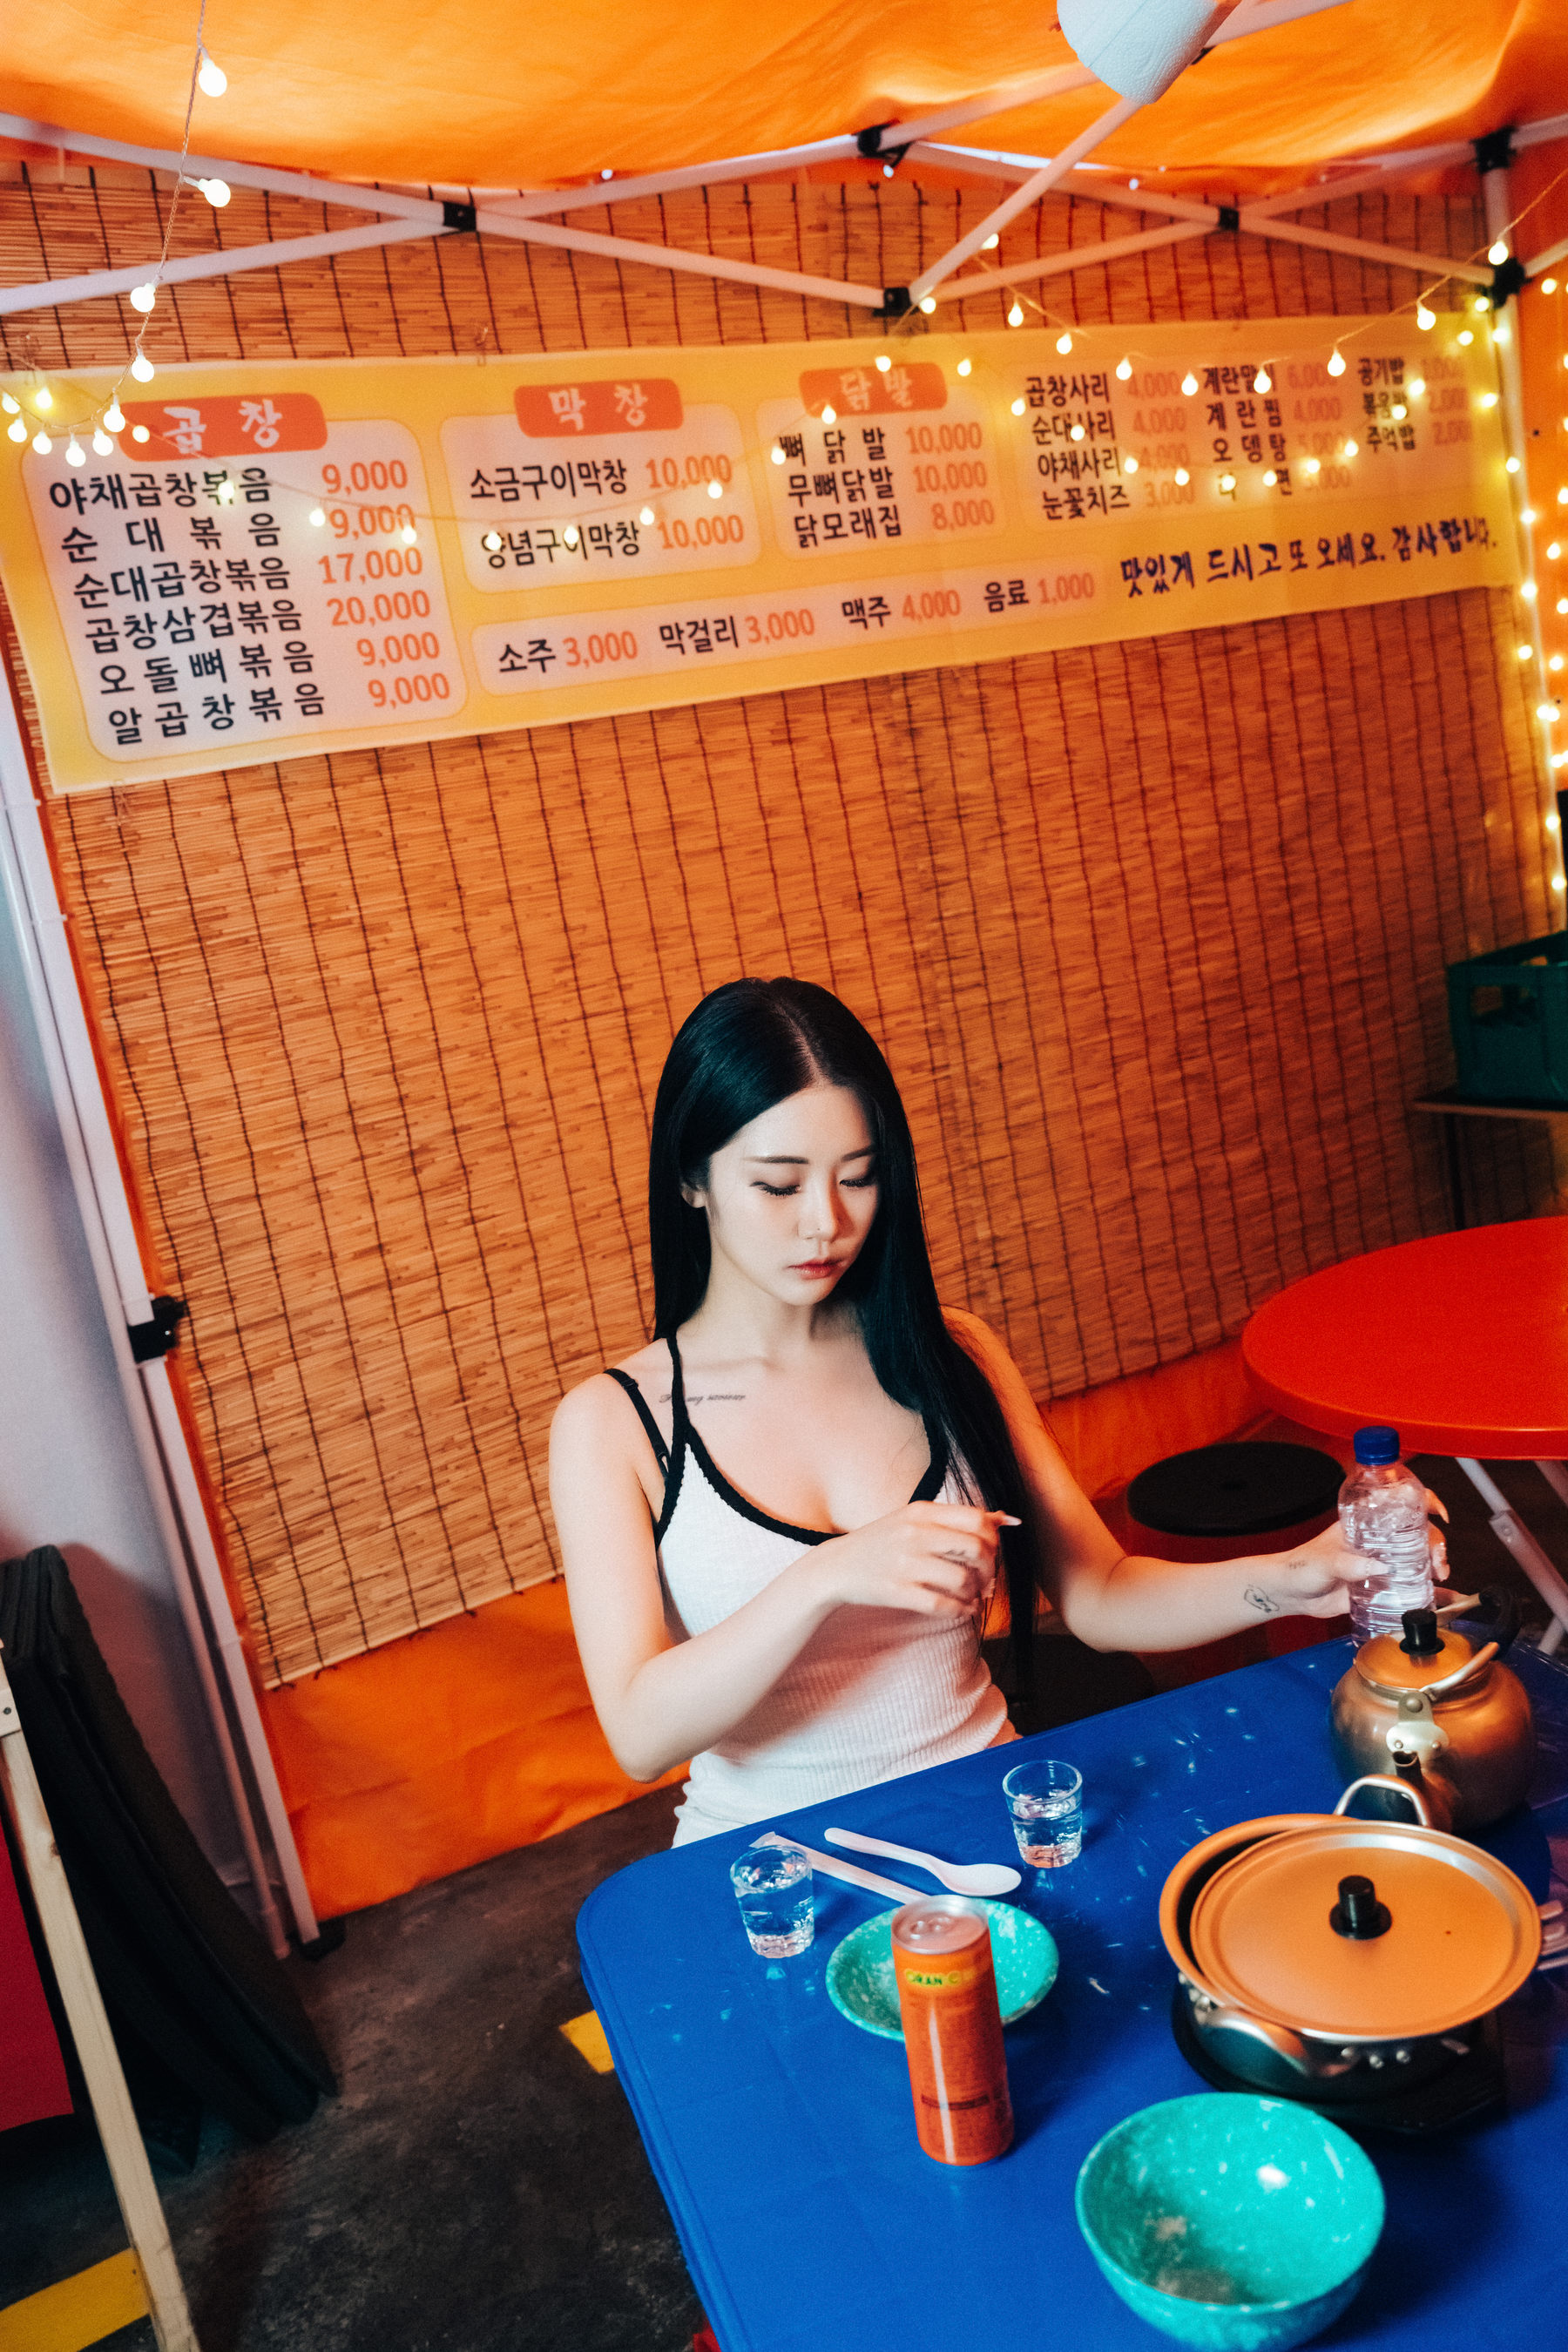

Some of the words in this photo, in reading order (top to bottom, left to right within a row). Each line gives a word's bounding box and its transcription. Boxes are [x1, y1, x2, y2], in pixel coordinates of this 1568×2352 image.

[1026, 373, 1110, 408] 곱창사리
[905, 422, 983, 455] 10,000
[471, 459, 626, 502] 소금구이막창
[645, 455, 732, 490] 10,000
[788, 466, 895, 507] 무뼈닭발
[912, 461, 988, 494] 10,000
[1038, 448, 1121, 482] 야채사리
[50, 468, 271, 515] 야채곱창볶음
[322, 461, 408, 495] 9,000
[1044, 485, 1130, 520] 눈꽃치즈
[330, 504, 416, 539] 9,000
[658, 515, 743, 550] 10,000
[794, 505, 902, 548] 닭모래집
[931, 499, 995, 531] 8,000
[74, 557, 290, 608] 순대곱창볶음
[319, 548, 422, 585] 17,000
[1120, 551, 1194, 598] 맛있게
[86, 599, 301, 653] 곱창삼겹볶음
[327, 590, 430, 626] 20,000
[499, 639, 556, 672] 소주
[563, 631, 638, 667] 3,000
[660, 616, 739, 654] 막걸리
[745, 609, 814, 645] 3,000
[841, 597, 890, 629] 맥주
[902, 590, 961, 622] 4,000
[984, 580, 1029, 613] 음료
[1037, 572, 1094, 605] 1,000
[357, 632, 440, 666] 9,000
[368, 672, 450, 708] 9,000
